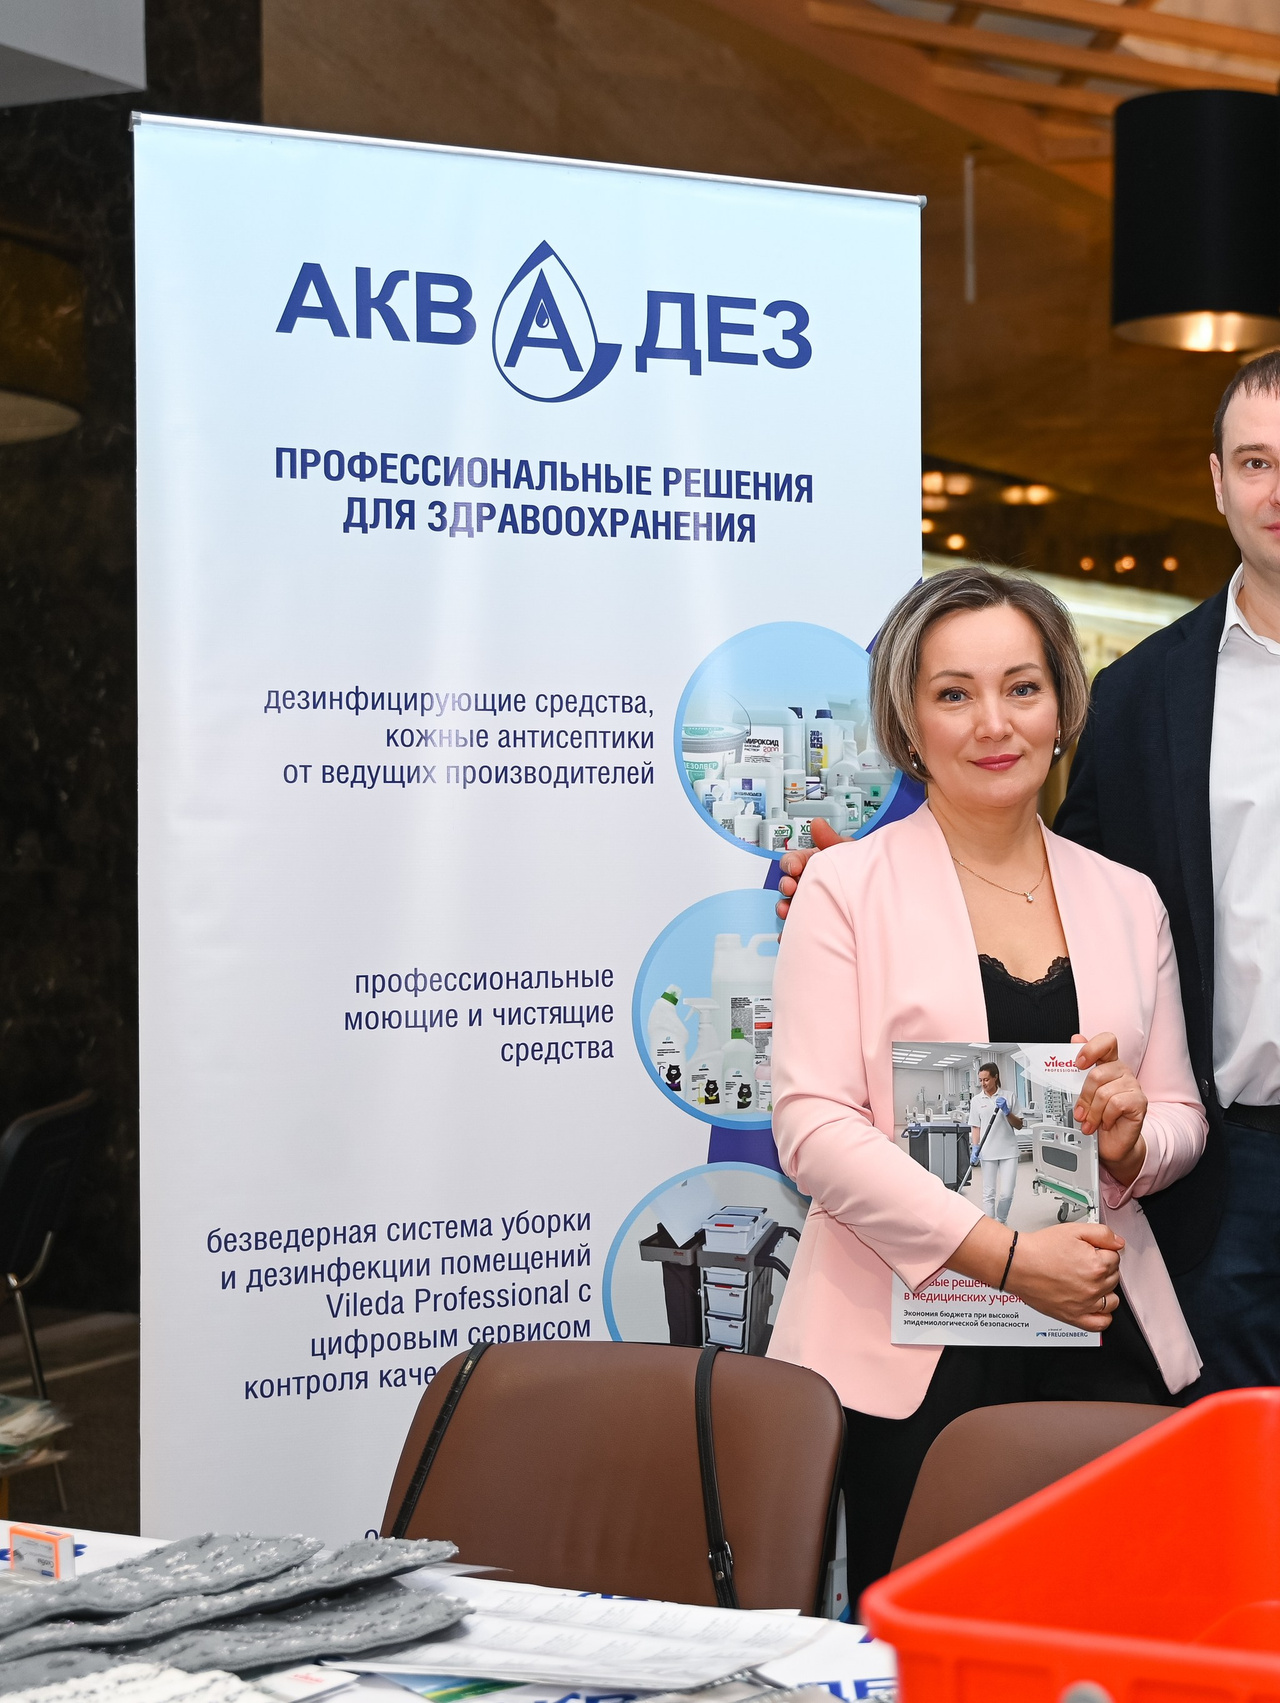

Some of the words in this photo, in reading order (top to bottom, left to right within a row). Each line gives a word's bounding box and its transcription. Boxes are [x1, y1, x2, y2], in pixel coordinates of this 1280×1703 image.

[276, 447, 652, 495] ПРОФЕССИОНАЛЬНЫЕ
[663, 467, 813, 503] РЕШЕНИЯ
[343, 497, 415, 534] ДЛЯ
[428, 500, 755, 543] ЗДРАВООХРАНЕНИЯ
[264, 685, 526, 717] дезинфицирующие
[536, 694, 653, 718] средства,
[387, 728, 488, 748] кожные
[498, 729, 653, 749] антисептики
[284, 764, 312, 783] от
[322, 765, 436, 789] ведущих
[447, 761, 654, 789] производителей
[356, 968, 613, 999] профессиональные
[345, 1009, 458, 1033] моющие
[469, 1008, 482, 1027] и
[493, 1004, 613, 1028] чистящие
[501, 1040, 614, 1067] средства
[207, 1224, 376, 1253] безведерная
[387, 1218, 493, 1242] система
[501, 1210, 590, 1241] уборки
[222, 1270, 235, 1290] и
[246, 1257, 430, 1292] дезинфекции
[441, 1243, 590, 1275] помещений
[326, 1290, 405, 1318] Vileda
[415, 1279, 568, 1313] Professional
[579, 1283, 591, 1302] с
[904, 1292, 910, 1300] в
[912, 1292, 987, 1303] медицинских
[903, 1319, 979, 1327] эпидемиологической
[979, 1320, 1030, 1328] безопасности
[939, 1310, 972, 1318] бюджета
[988, 1311, 1019, 1319] высокой
[311, 1328, 457, 1360] цифровым
[467, 1319, 591, 1345] сервисом
[245, 1371, 368, 1400] контроля
